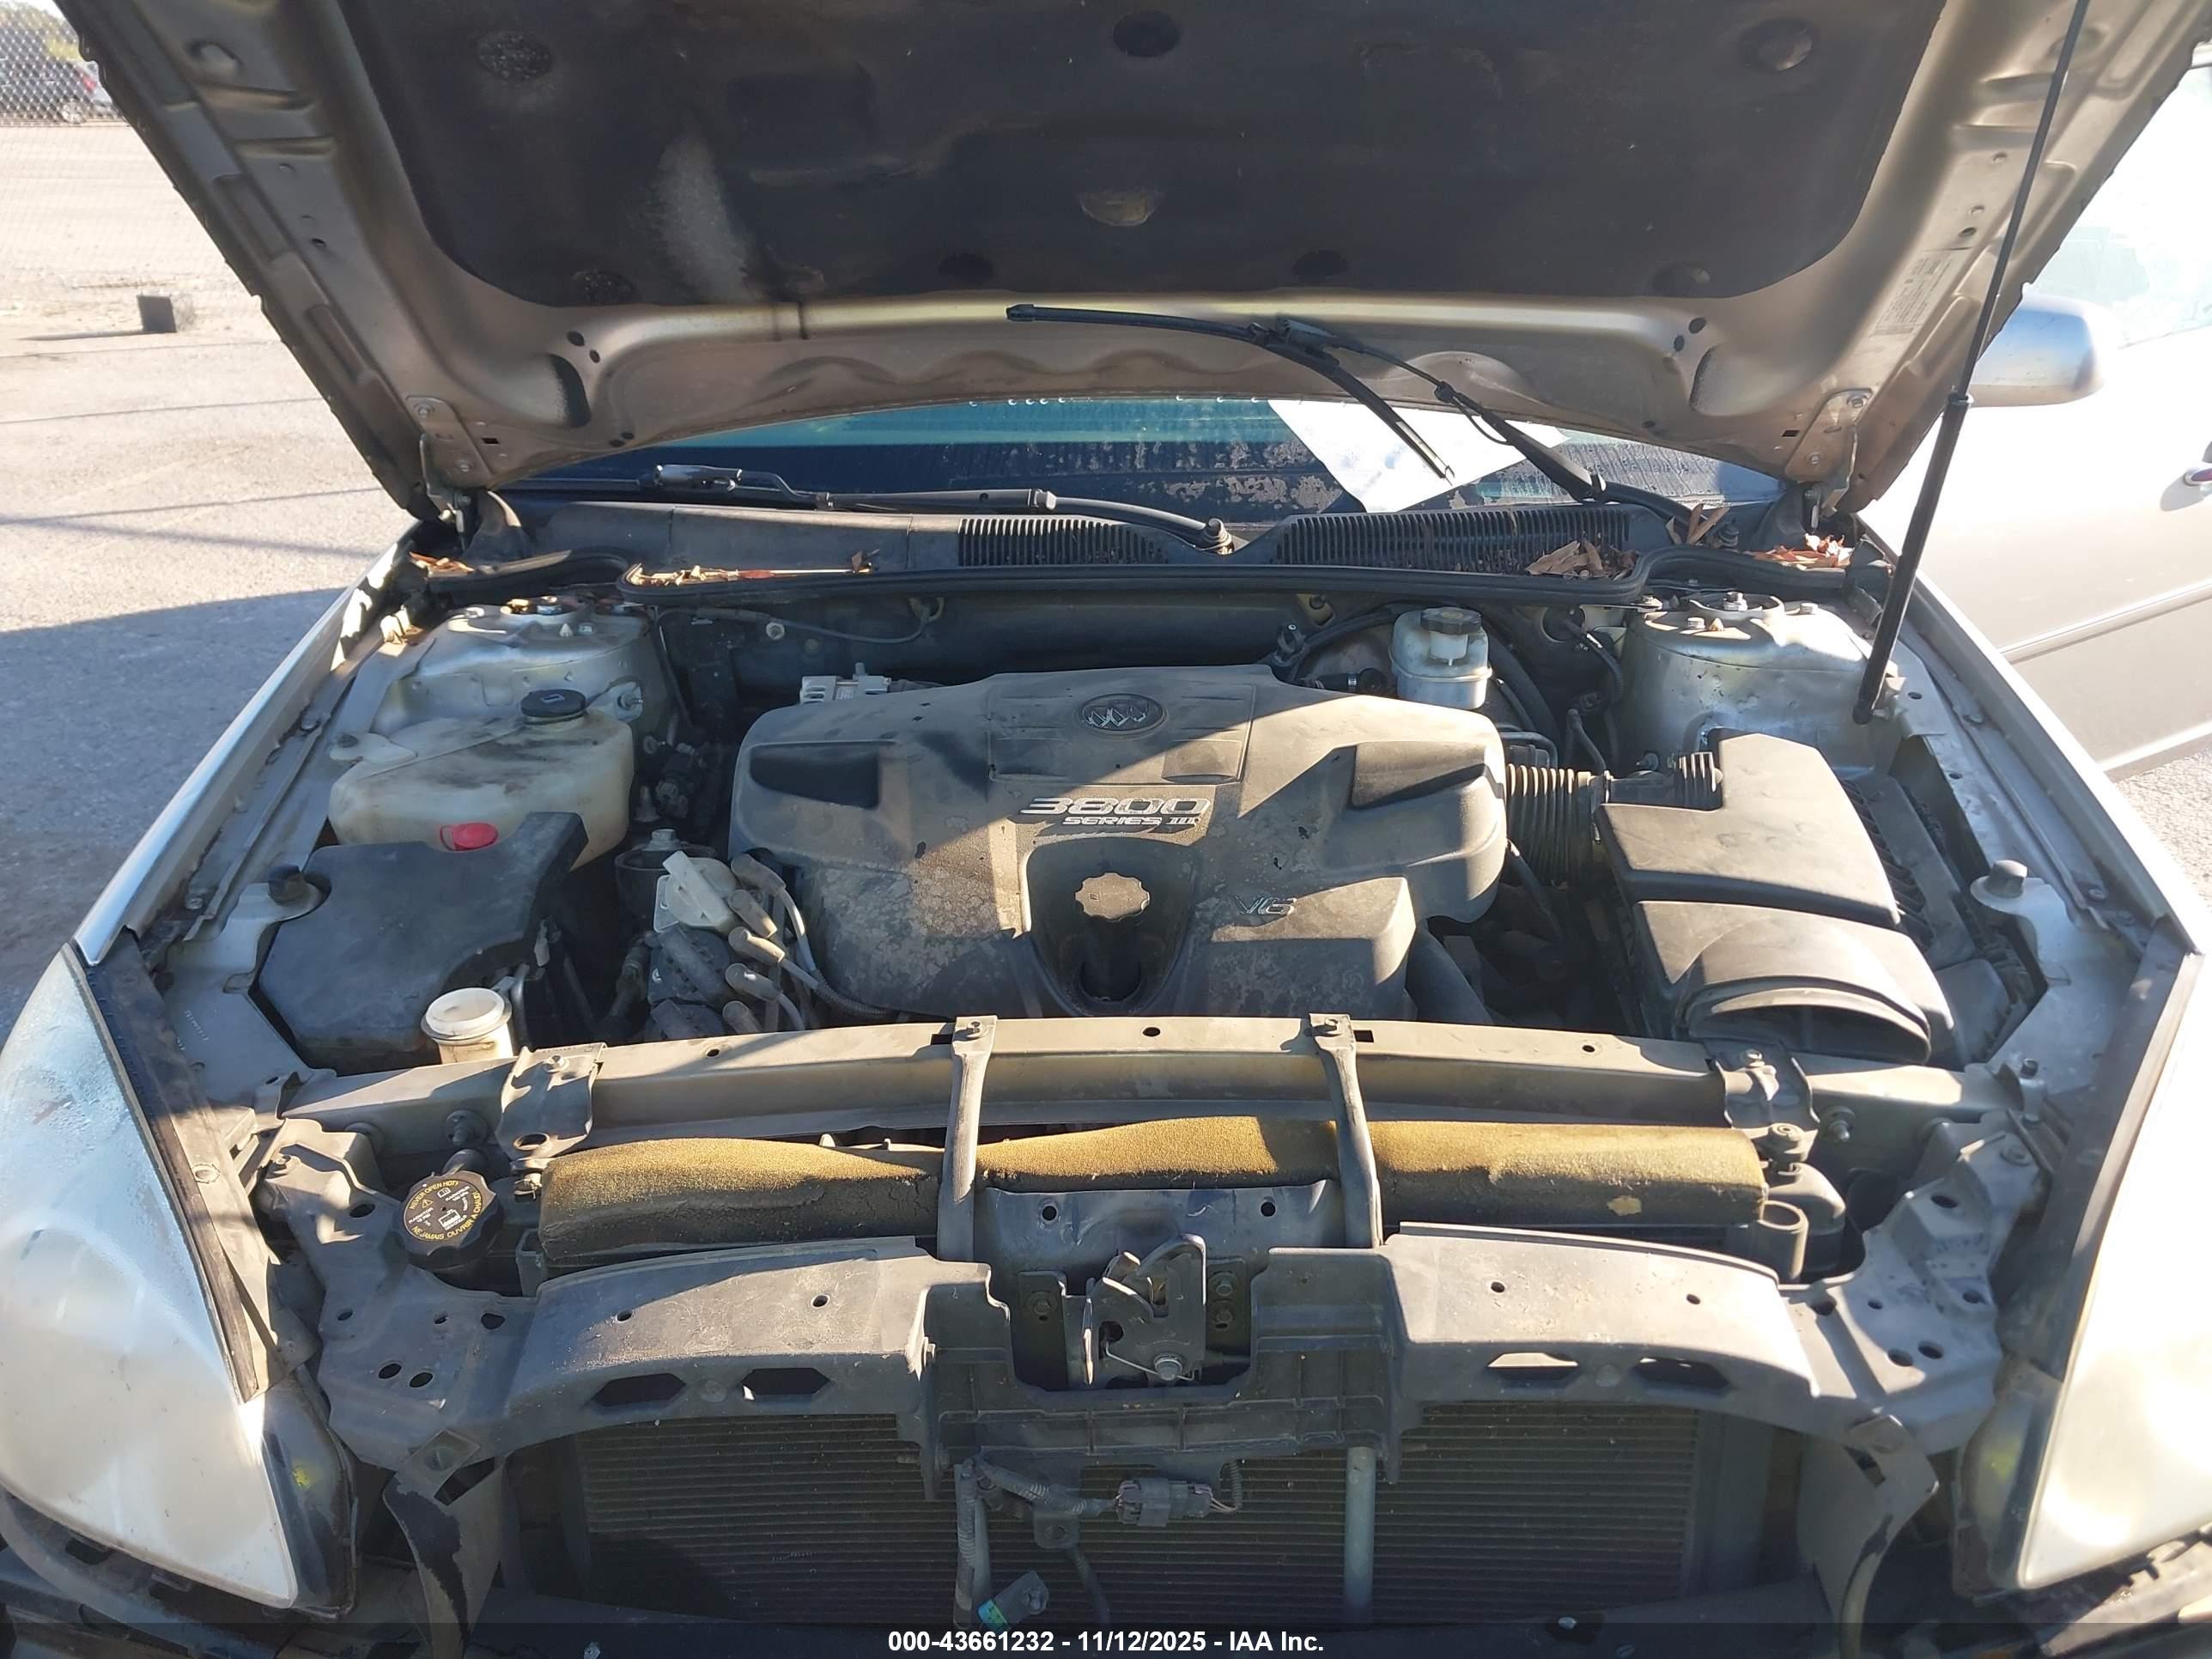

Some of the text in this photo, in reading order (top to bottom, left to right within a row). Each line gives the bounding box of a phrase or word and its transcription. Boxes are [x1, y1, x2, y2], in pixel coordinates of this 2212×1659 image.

[1020, 798, 1211, 815] 3800
[1062, 816, 1200, 825] SERIES III
[410, 1192, 426, 1210] NEVER
[425, 1182, 442, 1194] OPEN
[421, 1230, 445, 1240] JAMAIS
[447, 1218, 474, 1237] OUVRIR
